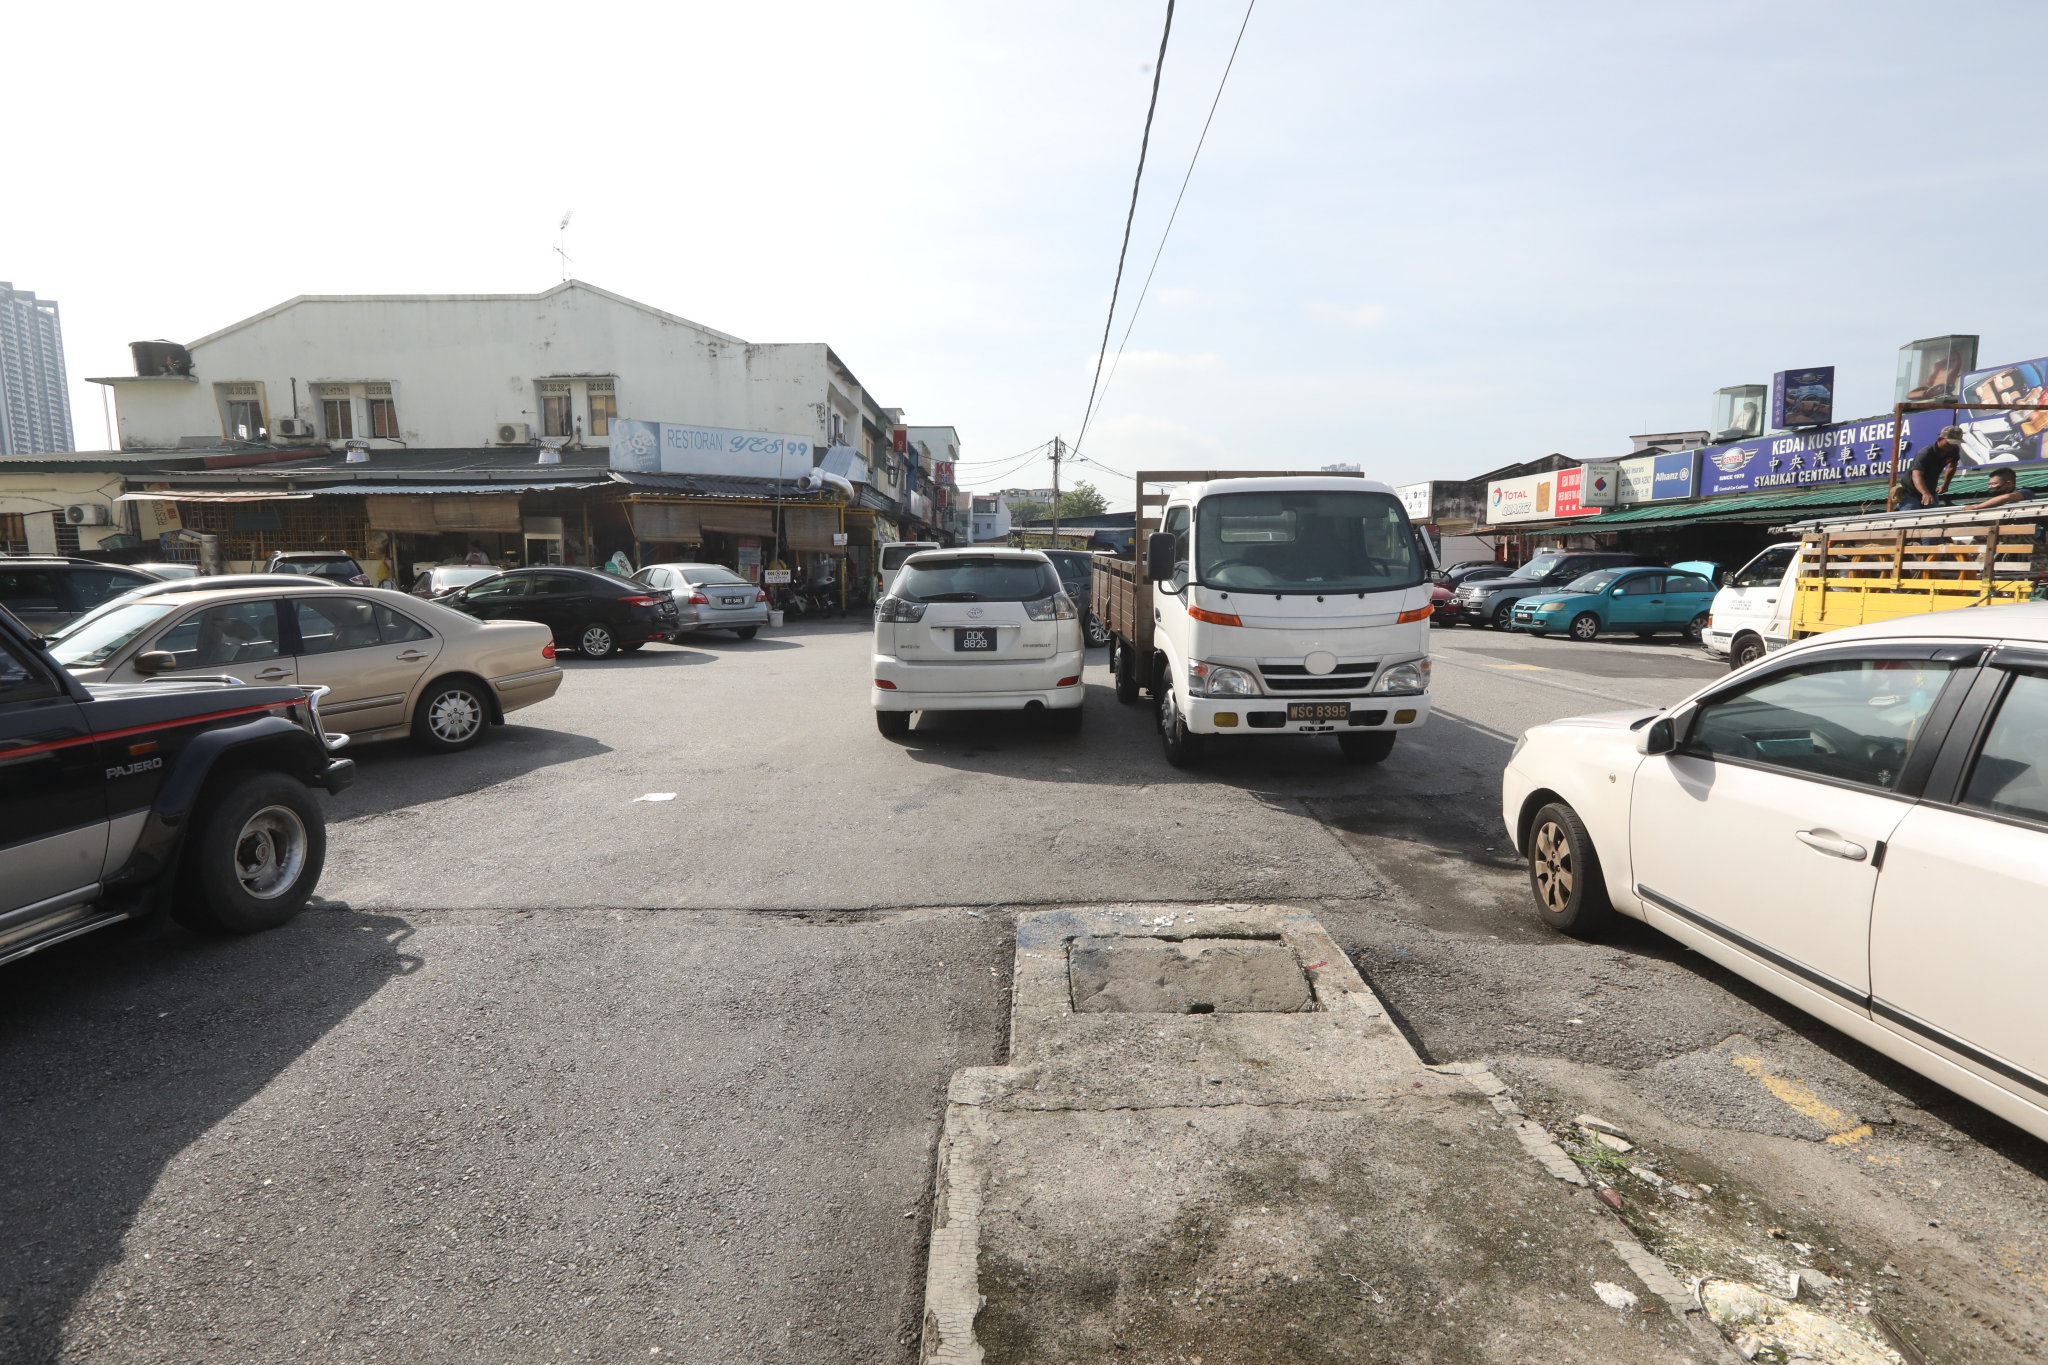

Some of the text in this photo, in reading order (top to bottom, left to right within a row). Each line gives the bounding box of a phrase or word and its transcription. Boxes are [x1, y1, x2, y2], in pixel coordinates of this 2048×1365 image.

[667, 429, 807, 456] RESTORAN YES 99
[1772, 420, 1911, 455] KEDAI KUSYEN KEREA
[1722, 454, 1744, 465] CENTRAL
[936, 462, 953, 474] KK
[1655, 472, 1679, 482] Allianz
[1754, 472, 1796, 488] SYARIKAT
[1799, 466, 1842, 483] CENTRAL
[1845, 463, 1867, 478] CAR
[1504, 490, 1528, 500] TOTAL
[1502, 502, 1531, 516] QUARTZ
[963, 639, 988, 649] 8828
[1291, 705, 1347, 719] WSC 8395
[106, 757, 163, 780] PAJERO
